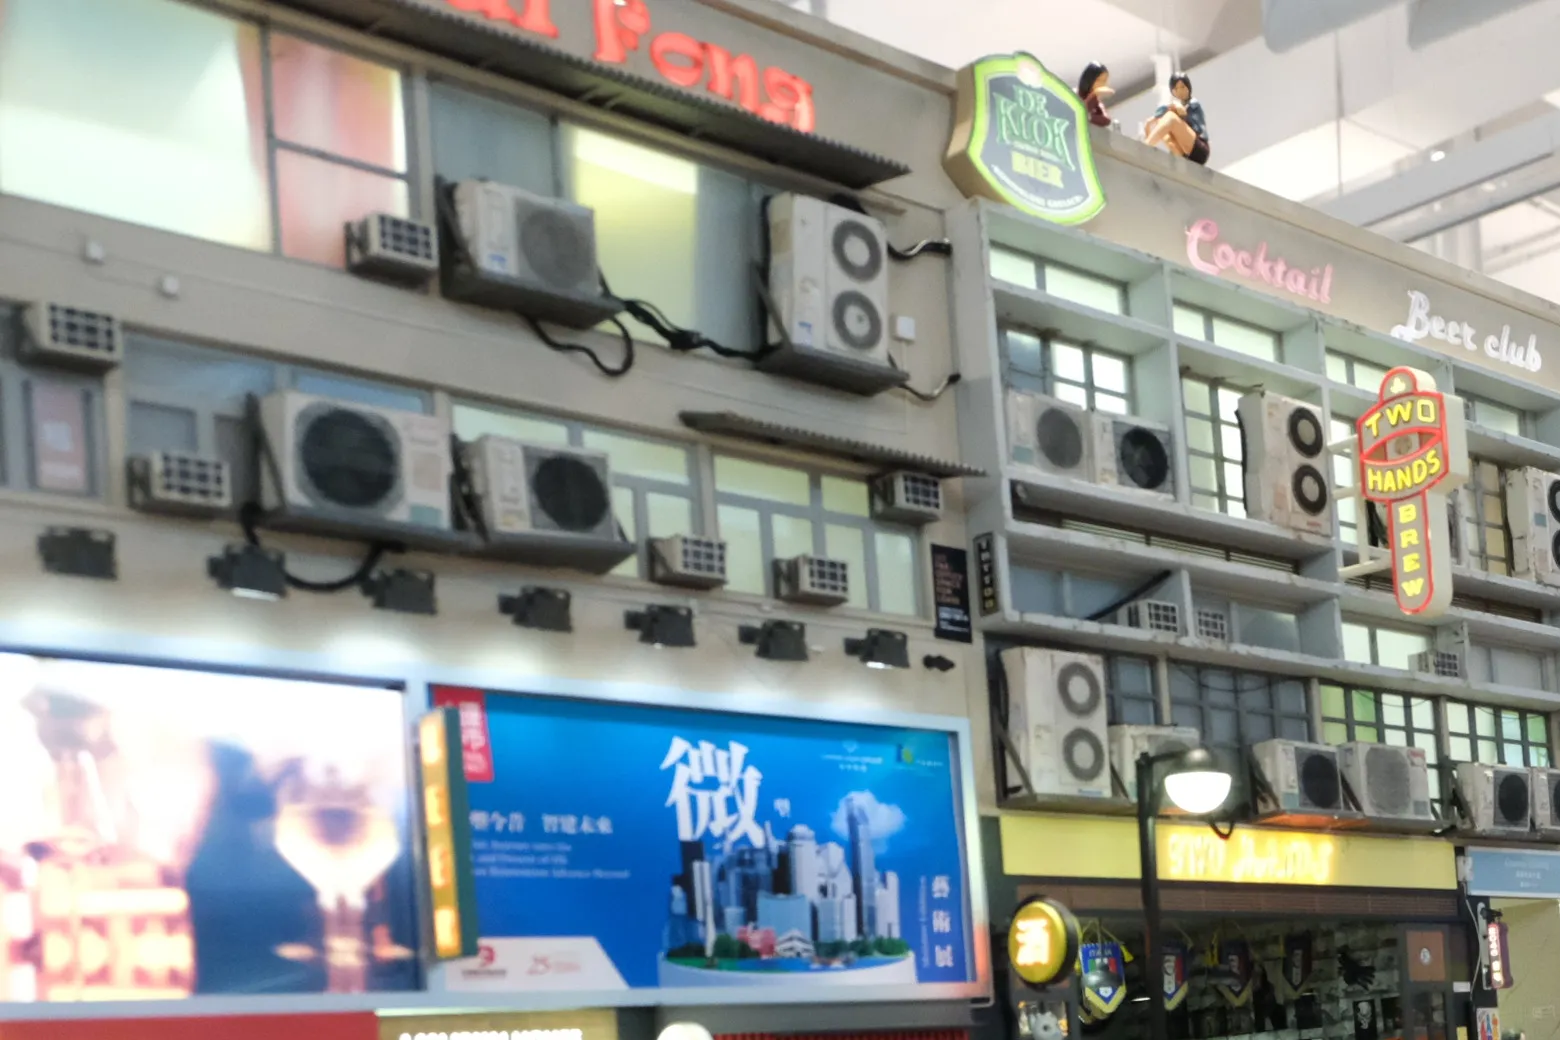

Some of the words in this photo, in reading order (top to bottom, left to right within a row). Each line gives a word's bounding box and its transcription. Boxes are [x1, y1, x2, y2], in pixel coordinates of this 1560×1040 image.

[1184, 218, 1333, 305] Cocktail
[1390, 290, 1478, 353] Beer
[1484, 324, 1542, 373] club
[1365, 398, 1436, 437] TWO
[1367, 449, 1441, 493] HANDS
[1398, 503, 1424, 597] BREW
[660, 735, 764, 850] 微
